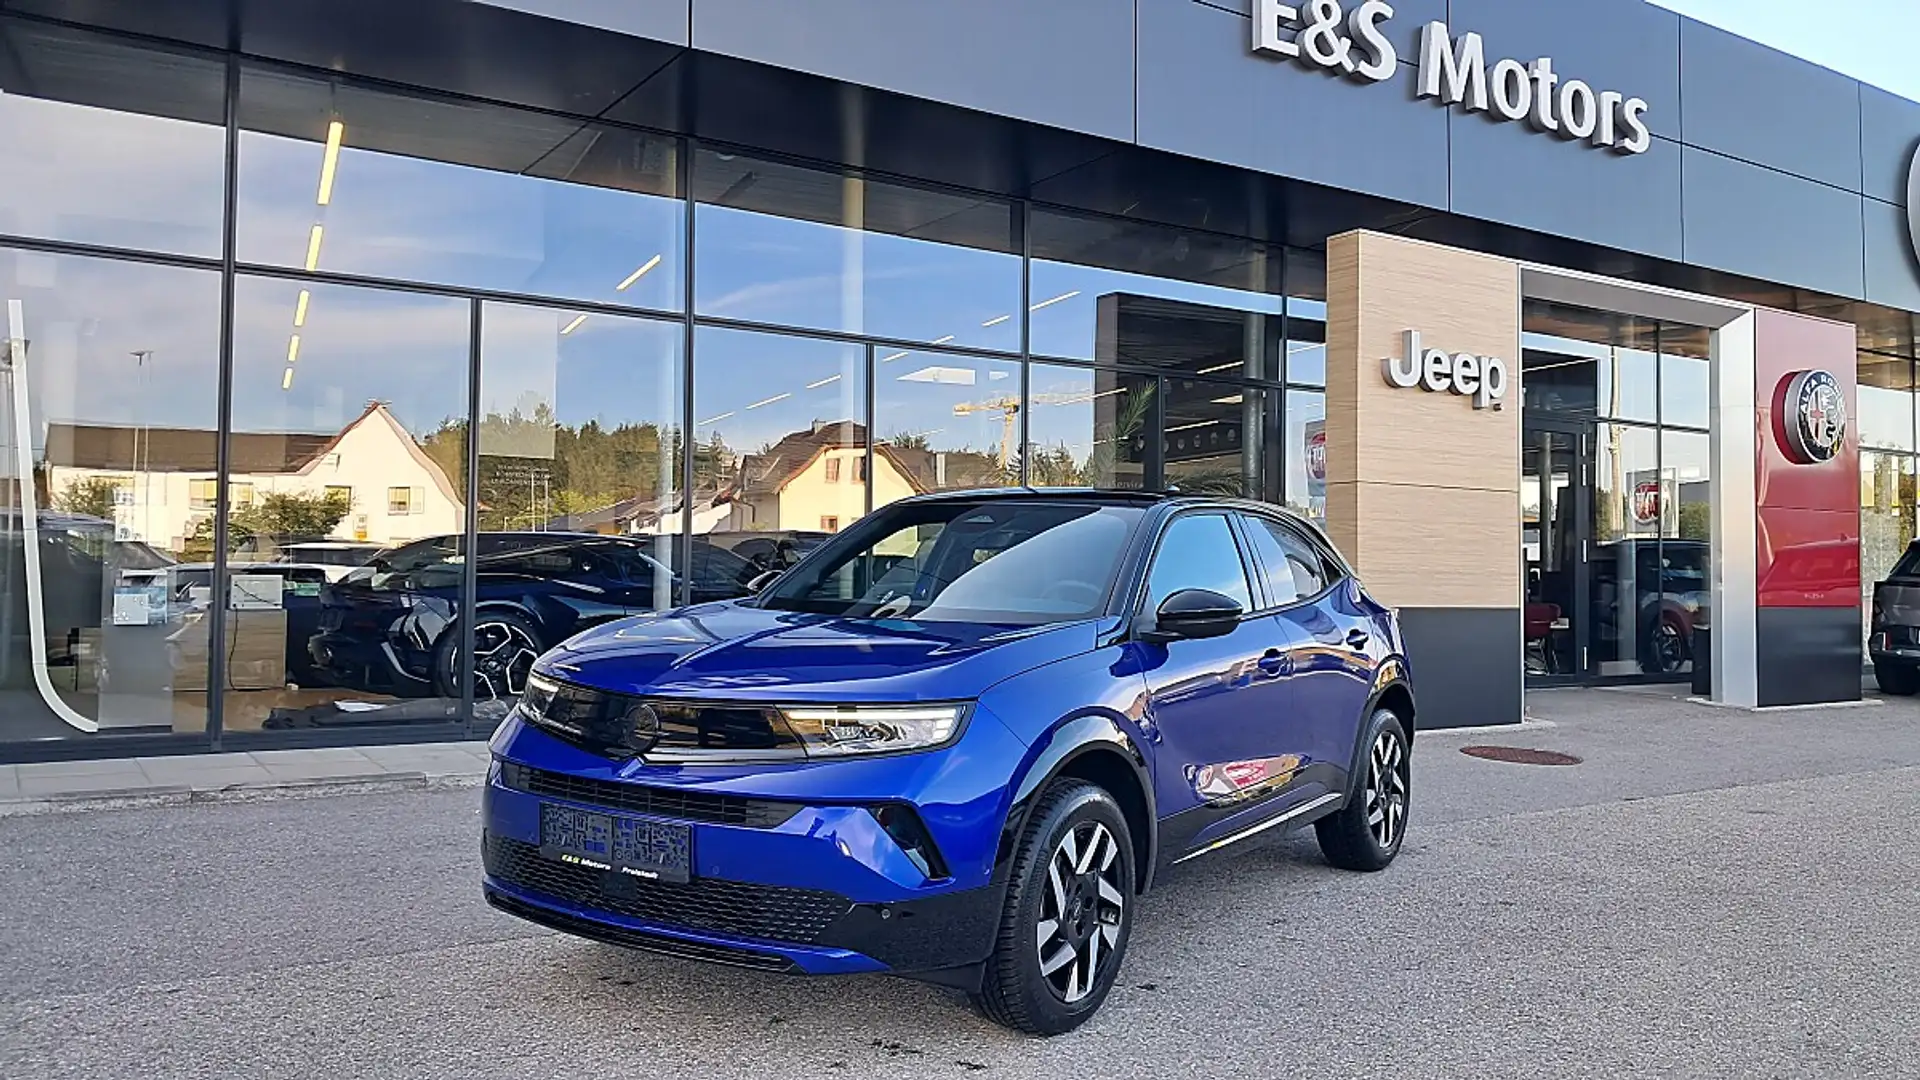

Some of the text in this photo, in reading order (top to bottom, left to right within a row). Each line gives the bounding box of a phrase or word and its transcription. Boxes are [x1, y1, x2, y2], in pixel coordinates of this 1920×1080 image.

[1252, 0, 1651, 155] E&S Motors
[1380, 329, 1507, 410] Jeep
[1800, 378, 1818, 414] ALFA
[580, 858, 612, 870] Motors
